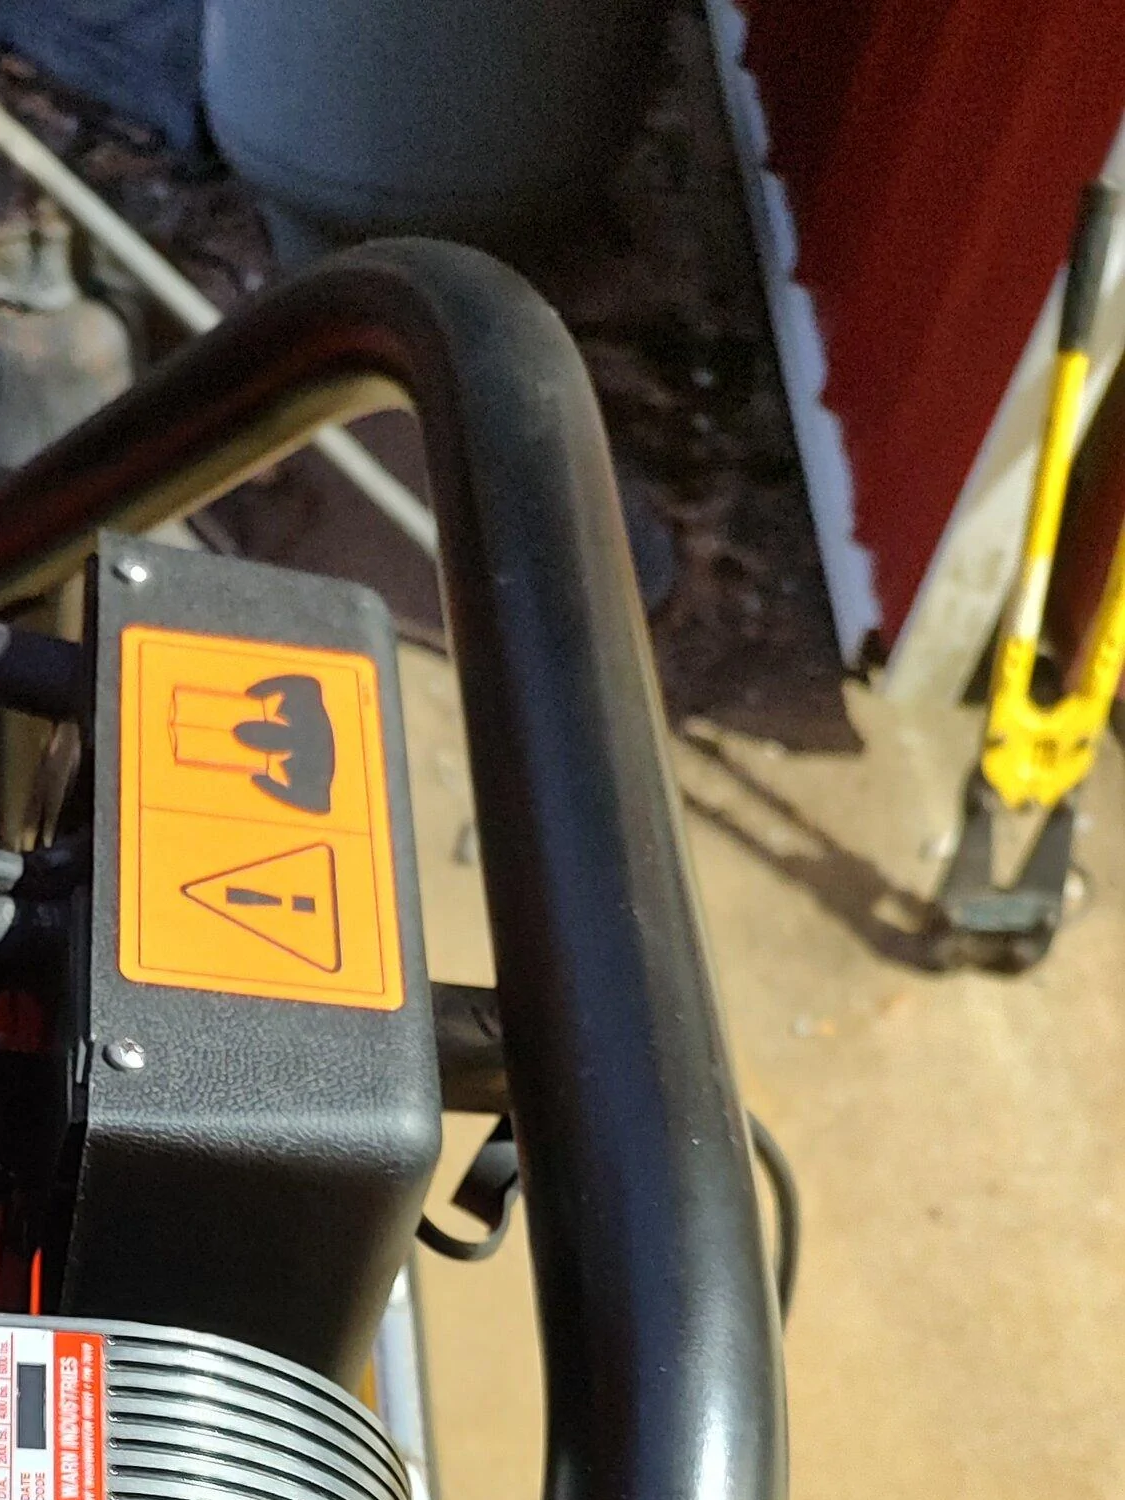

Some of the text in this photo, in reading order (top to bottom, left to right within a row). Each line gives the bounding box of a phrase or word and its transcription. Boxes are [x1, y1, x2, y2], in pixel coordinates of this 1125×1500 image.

[60, 1356, 79, 1499] WARN INDUSTRIES
[20, 1472, 31, 1500] DATE
